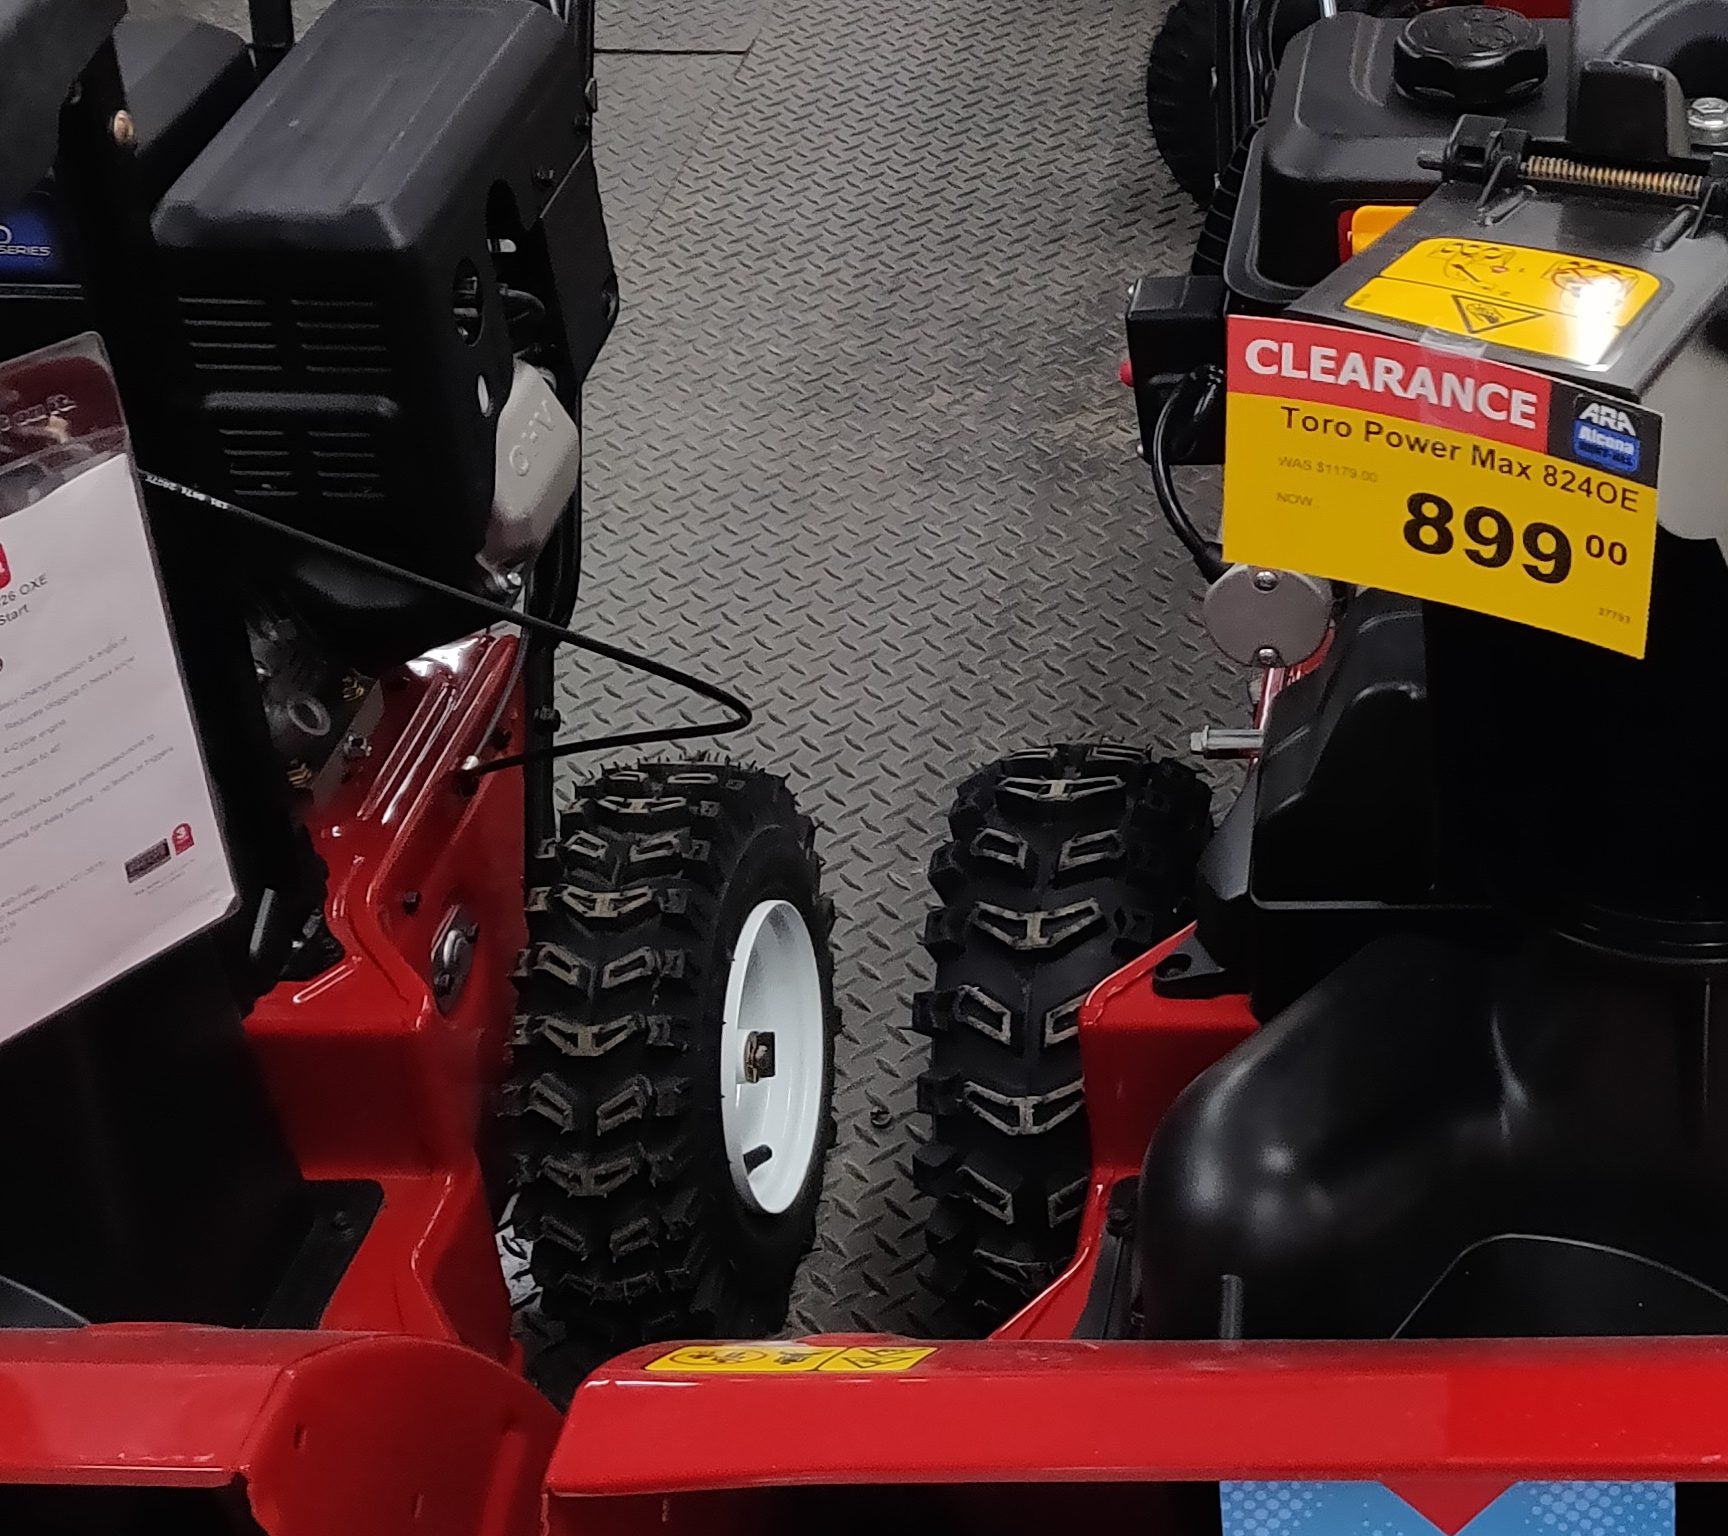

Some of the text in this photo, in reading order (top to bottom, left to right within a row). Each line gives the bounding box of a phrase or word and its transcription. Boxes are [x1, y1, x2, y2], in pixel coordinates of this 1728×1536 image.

[0, 245, 51, 256] SERIES
[1245, 338, 1538, 429] CLEARANCE
[1579, 402, 1637, 436] ARA
[1278, 456, 1378, 483] WAS $1179.00
[1280, 406, 1639, 513] Toro Power Max 824OE
[1276, 491, 1313, 506] NOW
[1403, 492, 1628, 584] 899 00
[0, 574, 48, 605] 26 OXE
